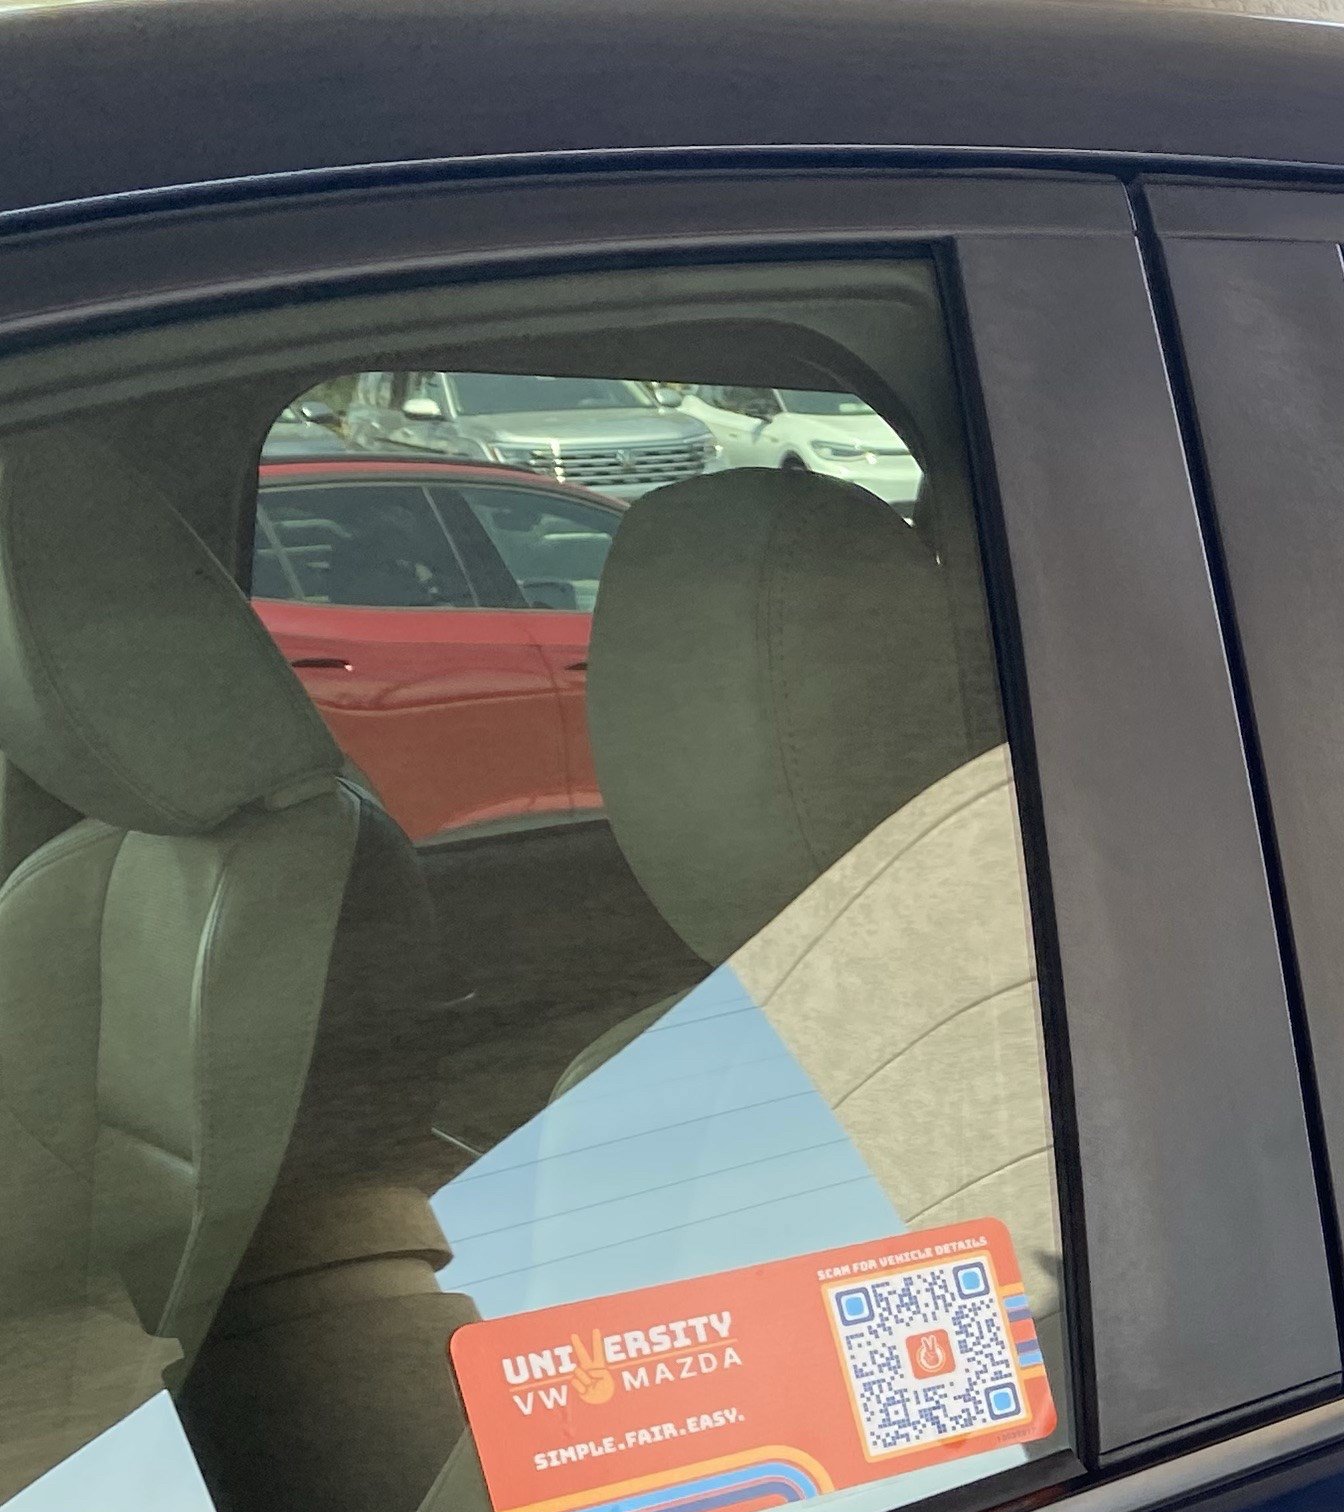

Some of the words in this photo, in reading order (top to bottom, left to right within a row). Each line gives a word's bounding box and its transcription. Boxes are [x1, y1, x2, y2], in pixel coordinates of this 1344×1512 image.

[817, 1264, 851, 1281] SCAN
[853, 1259, 878, 1274] FOR
[879, 1247, 934, 1268] VEHICLE
[935, 1236, 988, 1257] DETAILS
[501, 1311, 732, 1385] UNIVERSITY
[512, 1385, 568, 1416] VW
[621, 1347, 742, 1392] MAZDA
